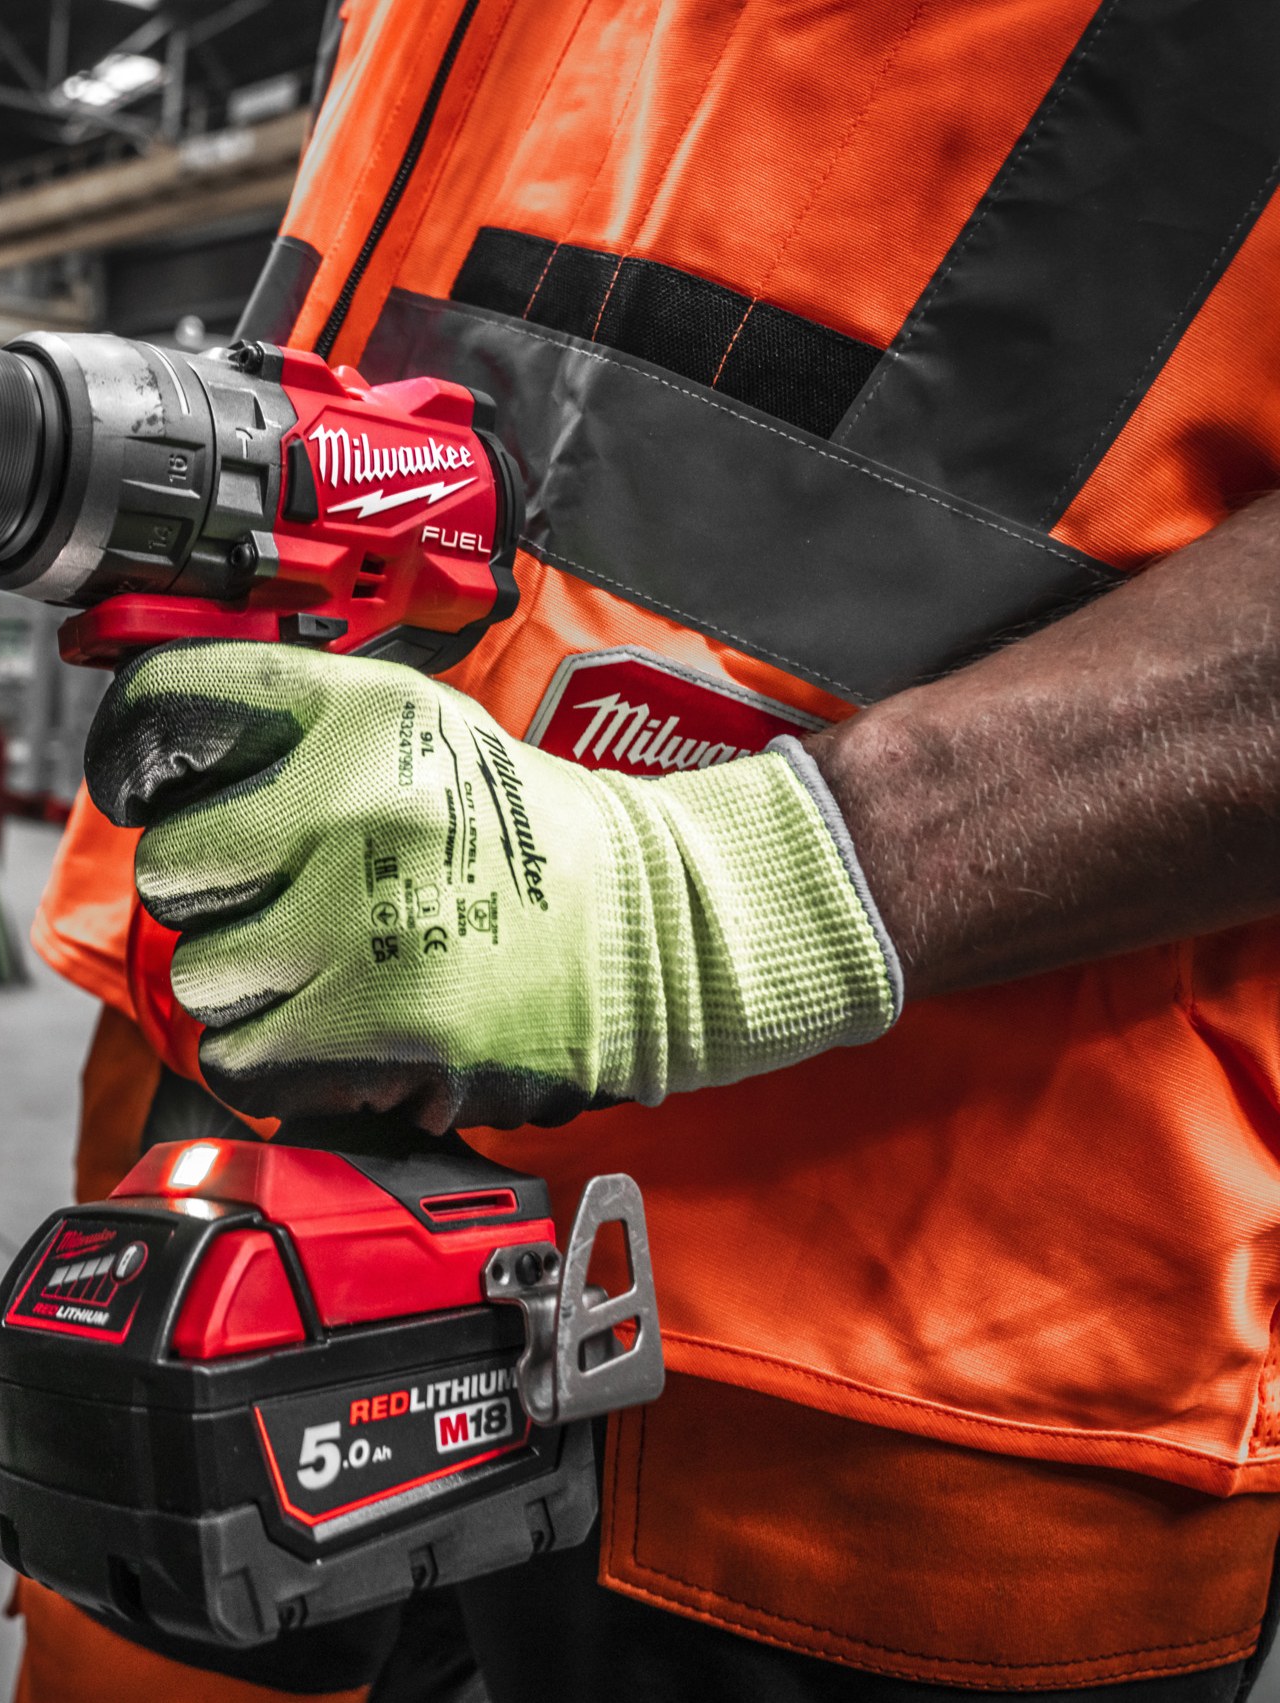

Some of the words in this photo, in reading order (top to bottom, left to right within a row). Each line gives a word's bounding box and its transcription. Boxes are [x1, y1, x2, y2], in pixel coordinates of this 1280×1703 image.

[308, 423, 475, 488] Milwaukee
[421, 525, 491, 553] FUEL
[398, 701, 416, 787] 4932479923
[420, 732, 434, 757] 9/L
[573, 693, 753, 770] Milwa
[464, 781, 475, 810] CUT
[468, 818, 477, 868] LEVEL
[424, 926, 447, 953] CE
[32, 1302, 110, 1325] REDLITHIUM
[349, 1368, 518, 1426] REDLITHIUM
[439, 1403, 508, 1446] M18
